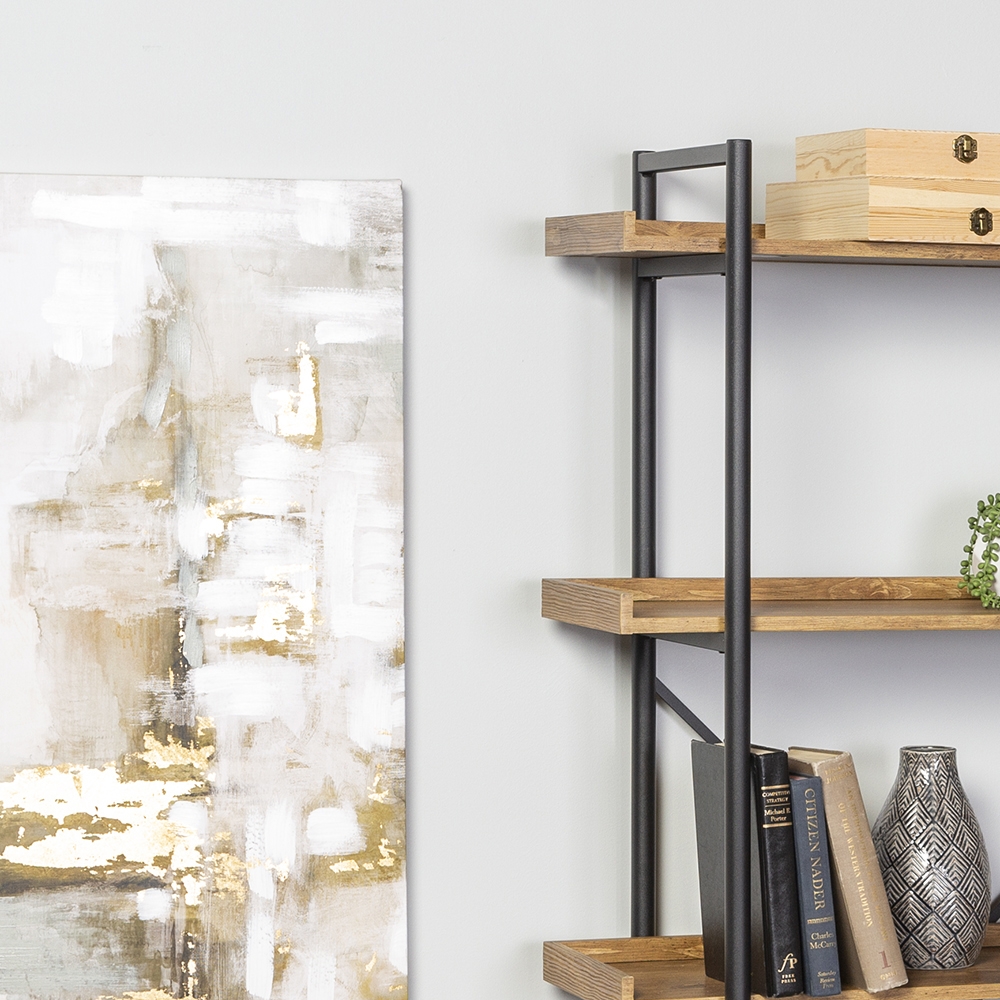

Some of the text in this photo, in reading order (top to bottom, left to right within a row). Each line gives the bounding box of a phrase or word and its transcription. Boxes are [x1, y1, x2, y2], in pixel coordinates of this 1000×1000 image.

[764, 808, 785, 816] Michael
[804, 788, 826, 911] CITIZEN NADER
[847, 837, 861, 878] WESTERN
[856, 879, 873, 927] TRADITION
[810, 932, 834, 941] Charles
